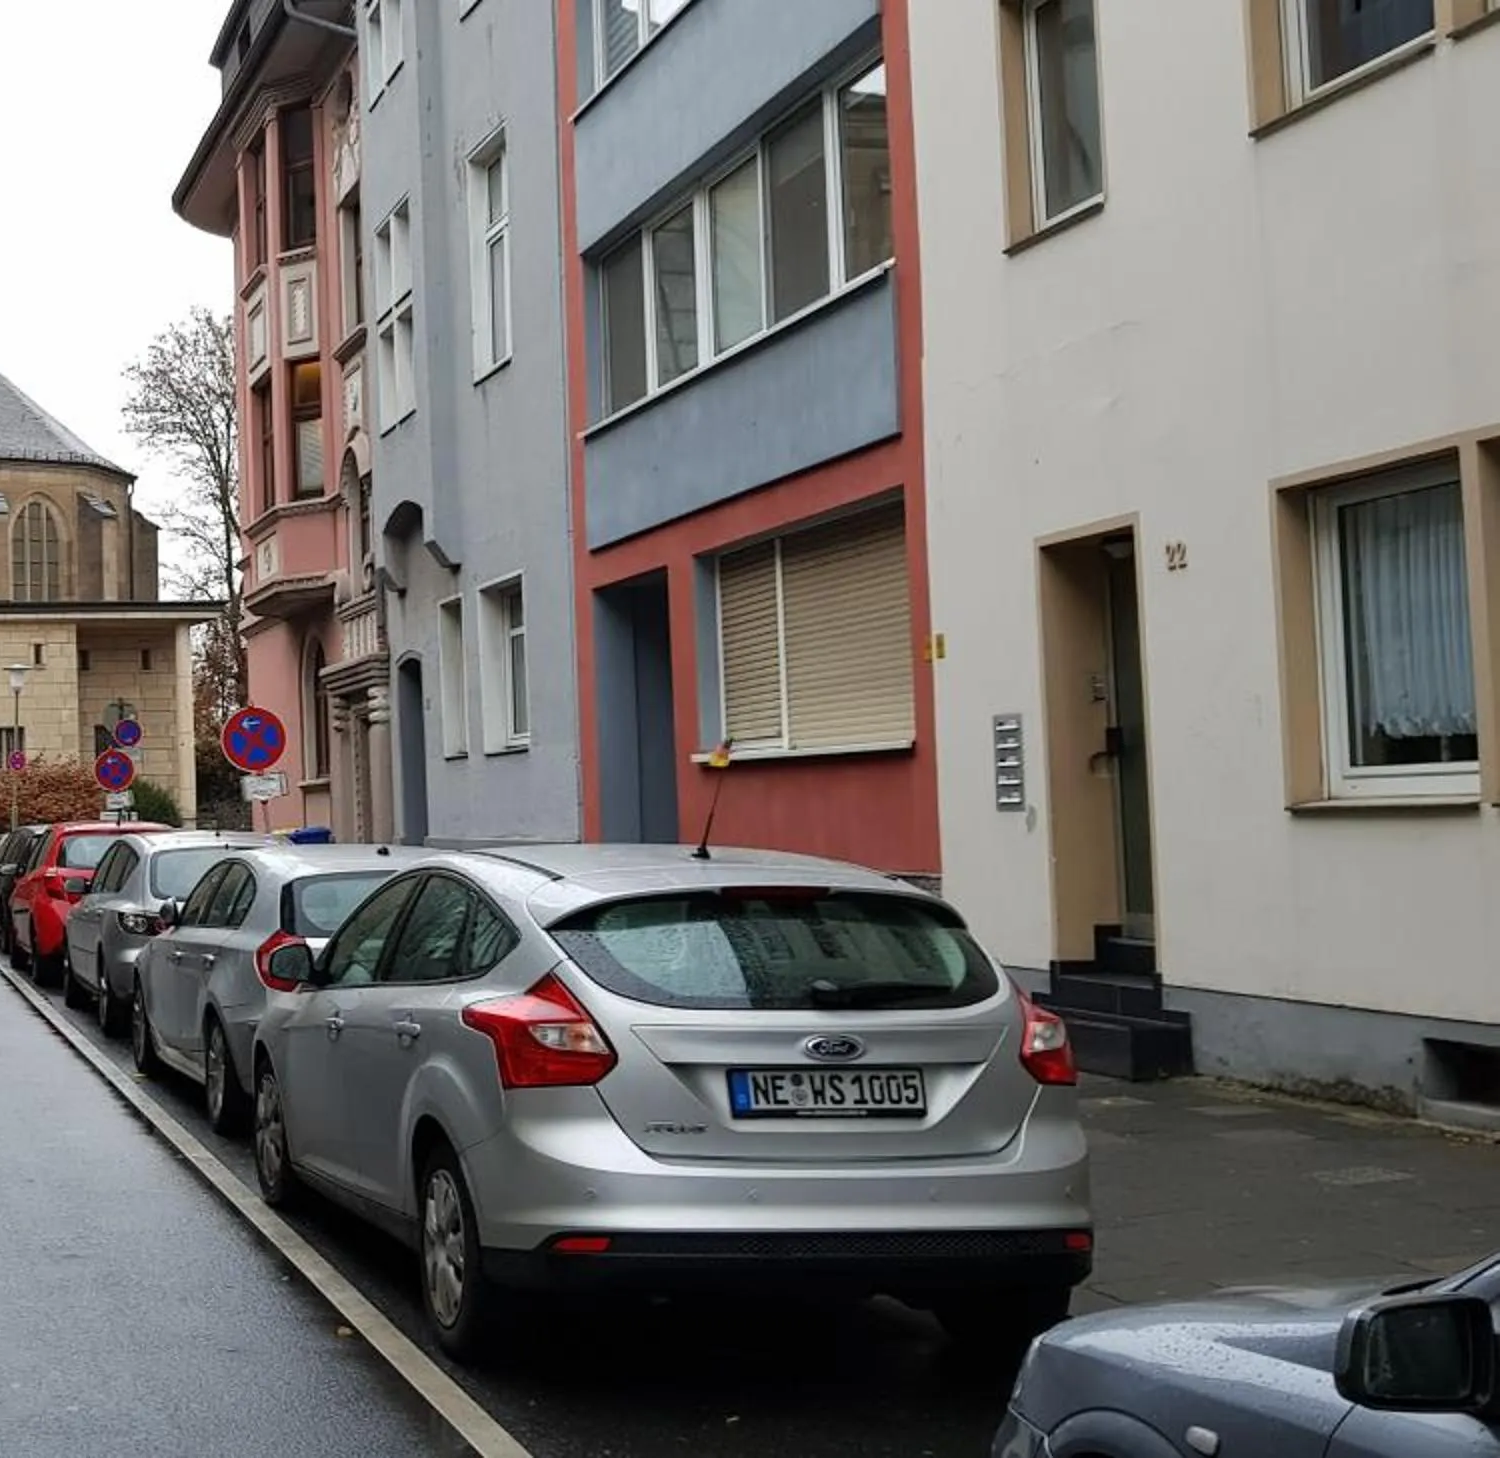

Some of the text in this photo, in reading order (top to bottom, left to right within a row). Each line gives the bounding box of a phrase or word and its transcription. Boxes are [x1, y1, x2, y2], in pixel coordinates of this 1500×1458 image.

[1164, 542, 1188, 571] 22
[751, 1073, 919, 1106] NE WS 1005
